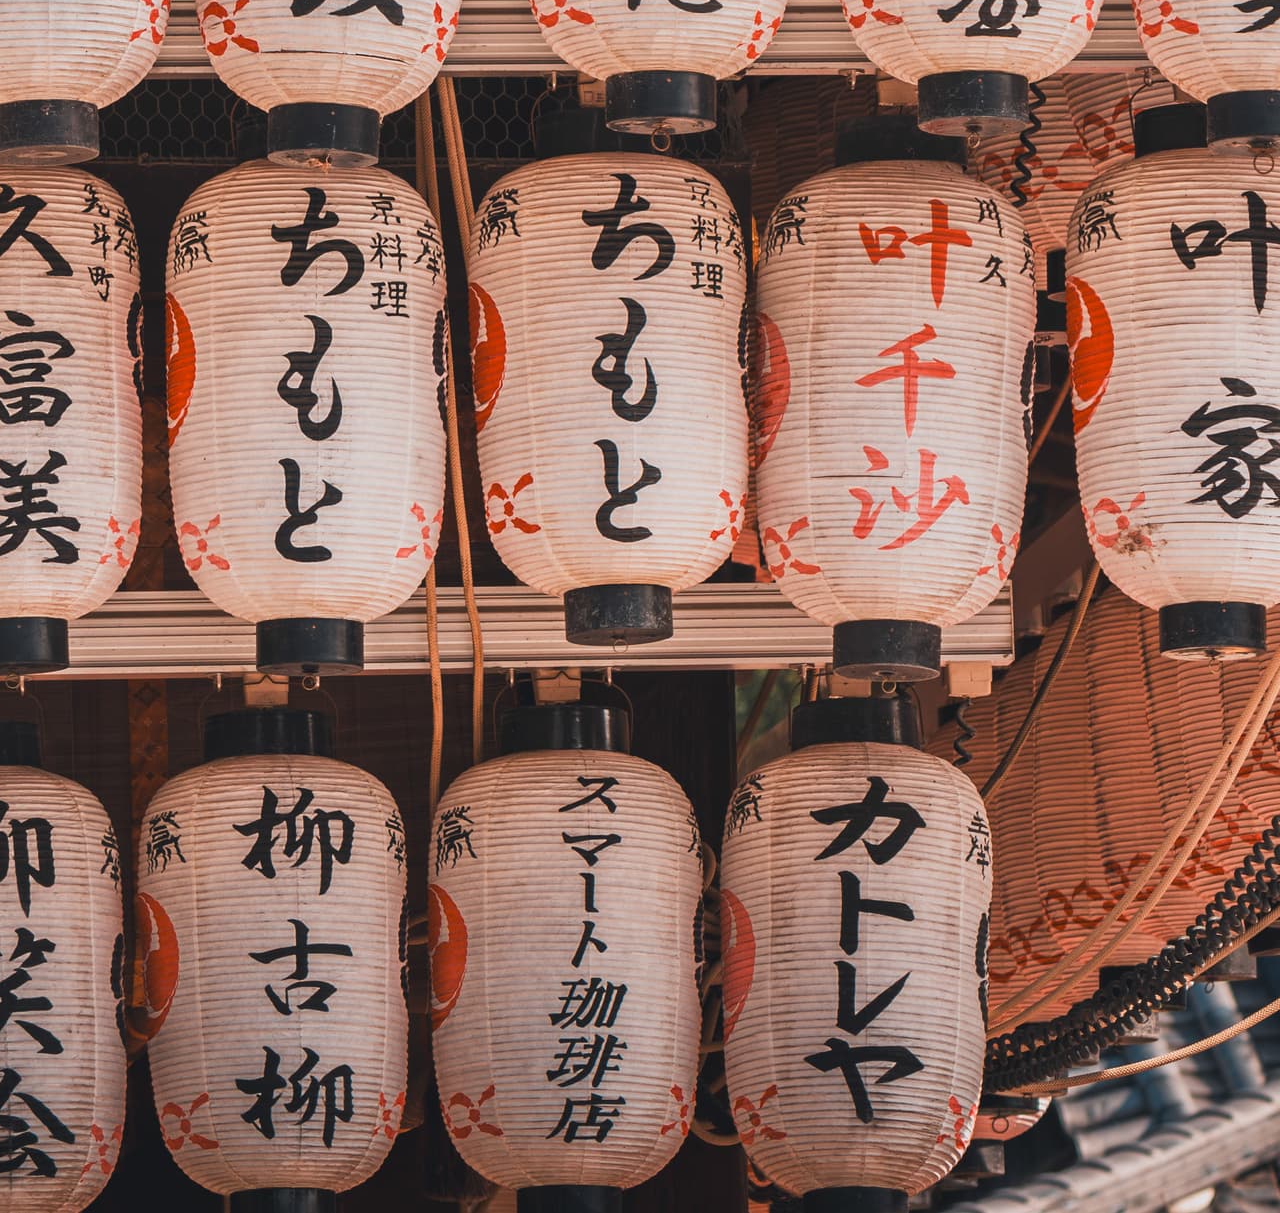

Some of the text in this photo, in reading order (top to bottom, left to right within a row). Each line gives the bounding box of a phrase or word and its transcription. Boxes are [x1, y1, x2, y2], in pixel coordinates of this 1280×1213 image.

[82, 183, 118, 303] 先斗町
[270, 186, 367, 565] ちもと
[369, 191, 411, 319] 京料理
[581, 171, 677, 544] ちもと
[683, 177, 726, 301] 京料理
[848, 197, 973, 553] 叶千沙
[976, 197, 1008, 288] 川久
[232, 785, 357, 1150] 柳古柳
[545, 774, 628, 1144] スマート珈琲店
[803, 775, 927, 1126] カトレヤ
